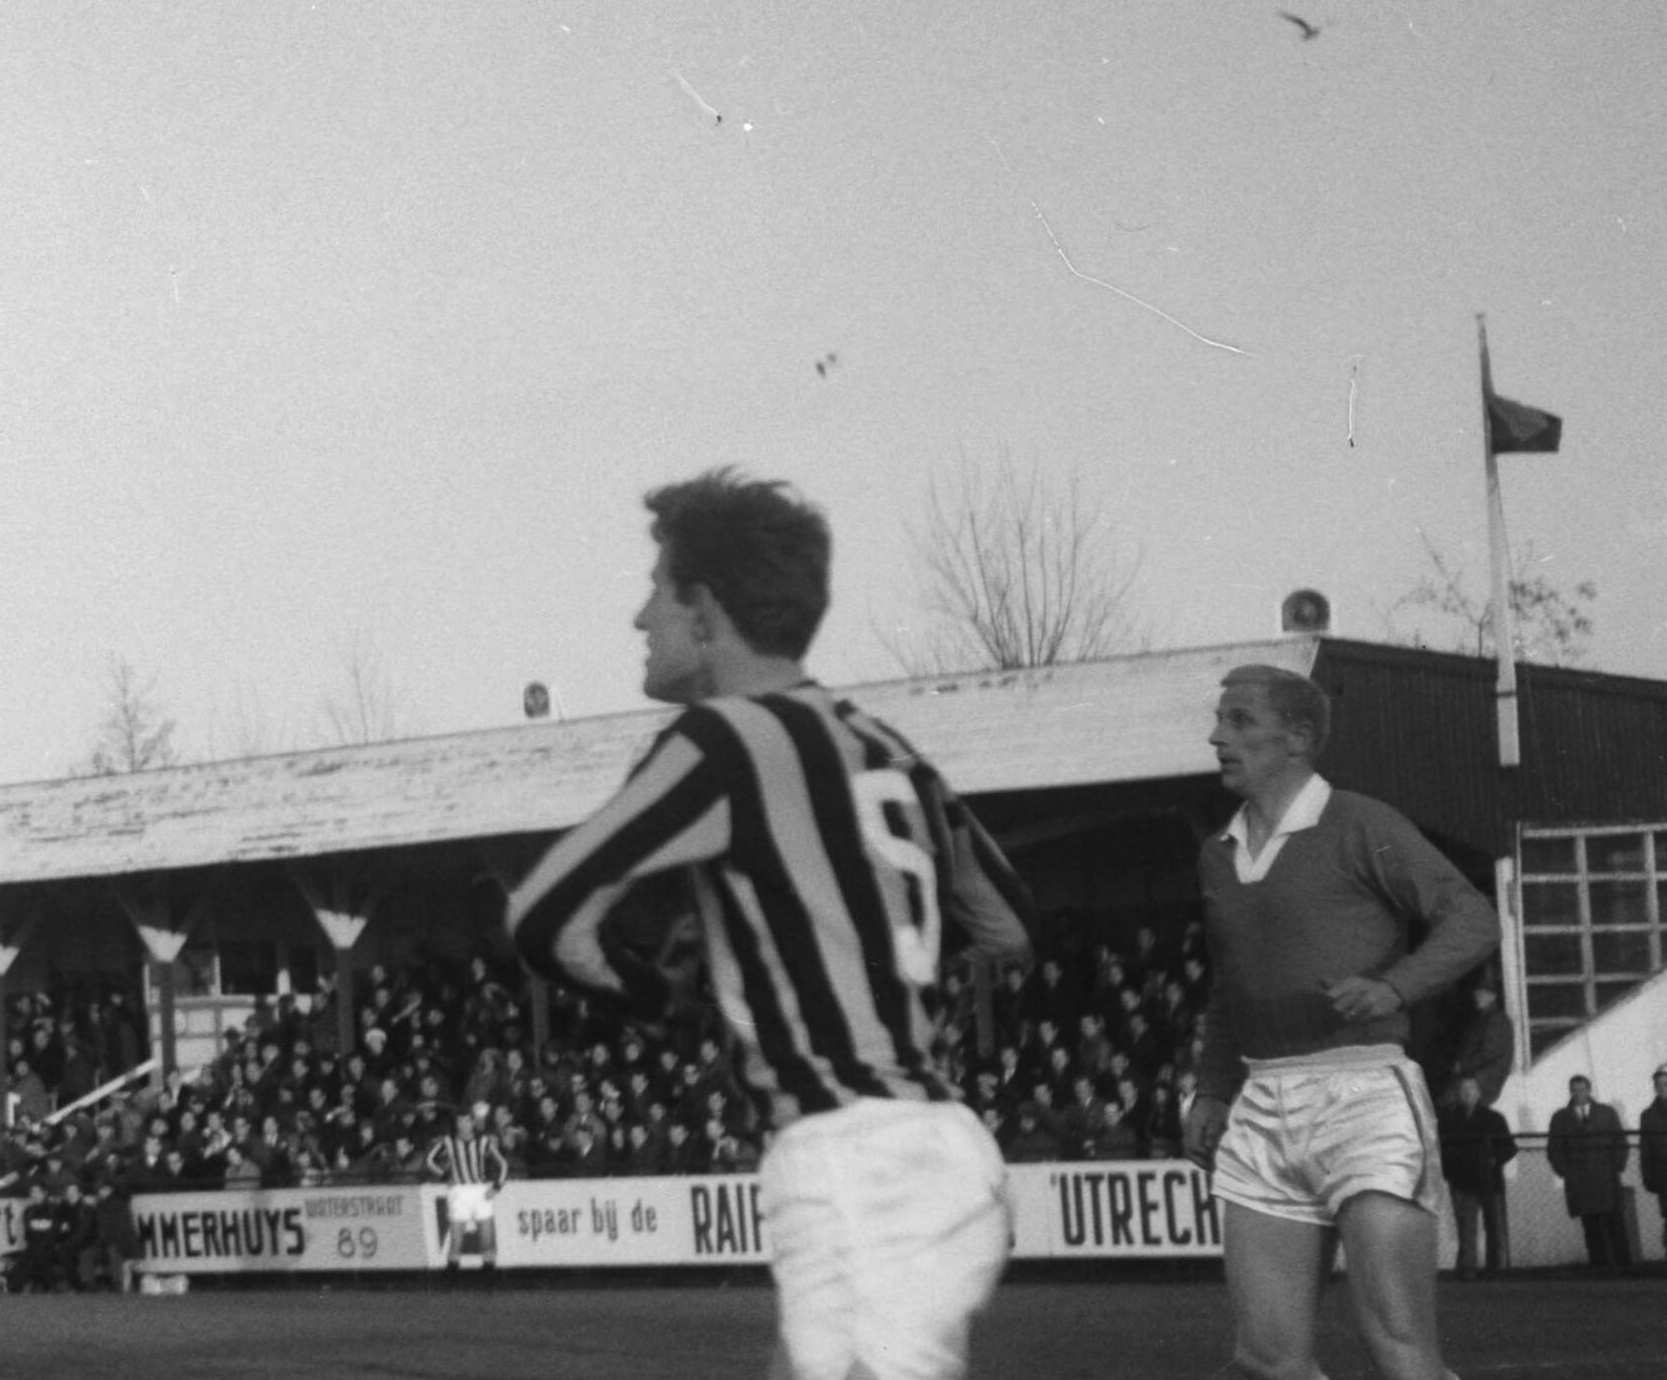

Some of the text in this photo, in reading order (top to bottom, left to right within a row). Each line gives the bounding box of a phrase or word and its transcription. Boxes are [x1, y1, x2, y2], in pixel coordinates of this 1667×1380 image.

[518, 1208, 581, 1241] spaar
[630, 1200, 657, 1234] de
[337, 1226, 379, 1259] 89
